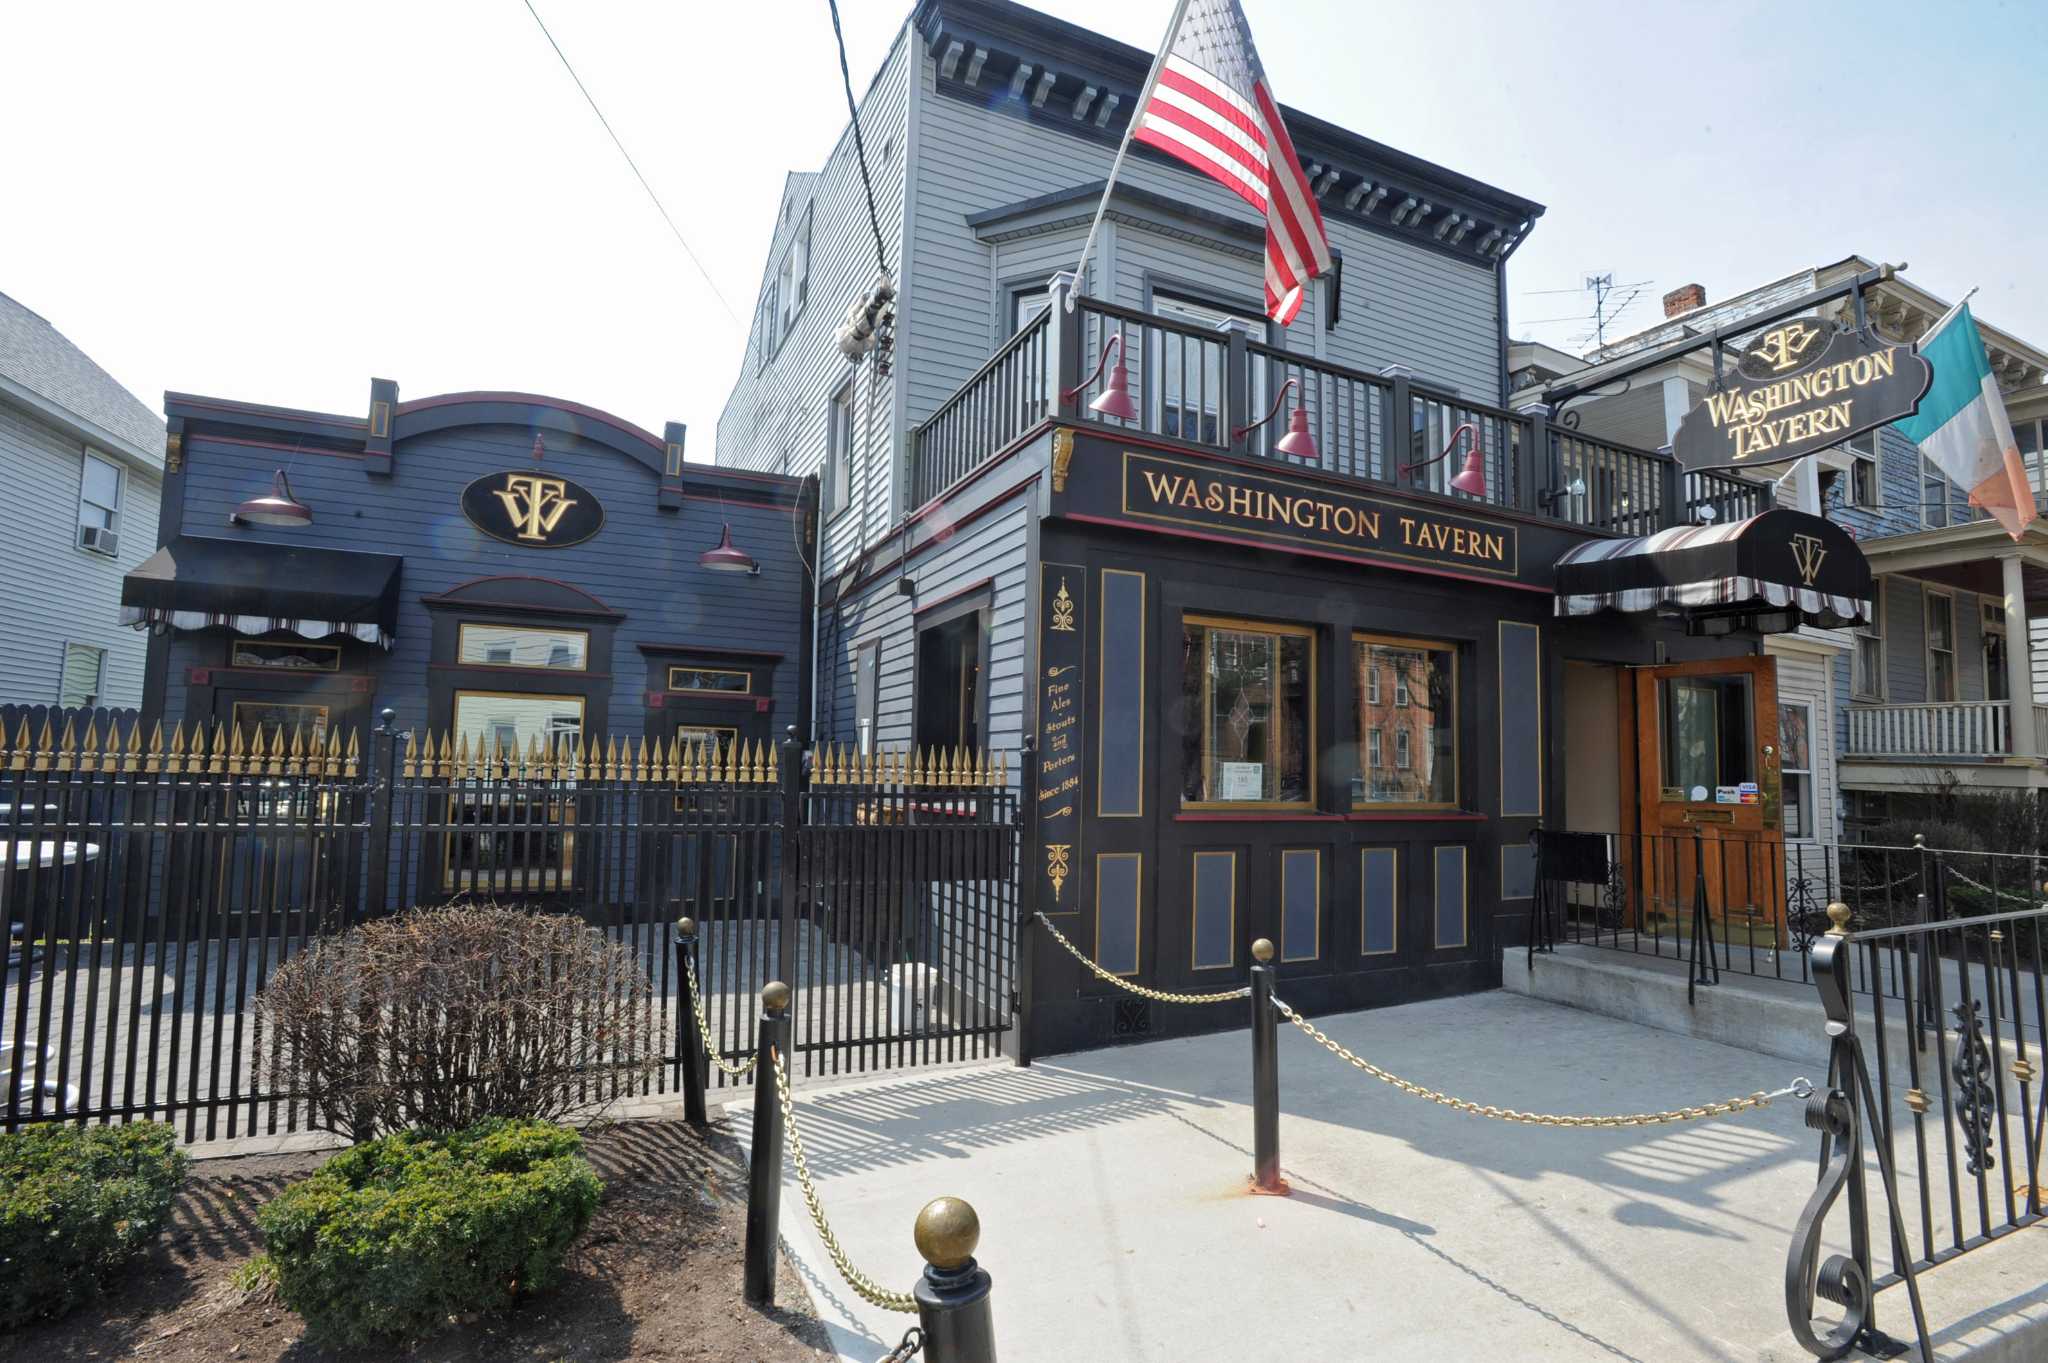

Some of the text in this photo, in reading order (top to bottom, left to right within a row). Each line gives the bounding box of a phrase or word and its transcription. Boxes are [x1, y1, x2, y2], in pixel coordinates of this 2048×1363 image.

[1703, 346, 1897, 428] WASHINGTON
[1727, 399, 1853, 460] TAVERN
[1143, 470, 1504, 561] WASHINGTON TAVERN
[1048, 683, 1070, 697] Fine
[1050, 696, 1072, 713] Ales
[1045, 716, 1077, 733] Stouts
[1043, 754, 1076, 773] Porters
